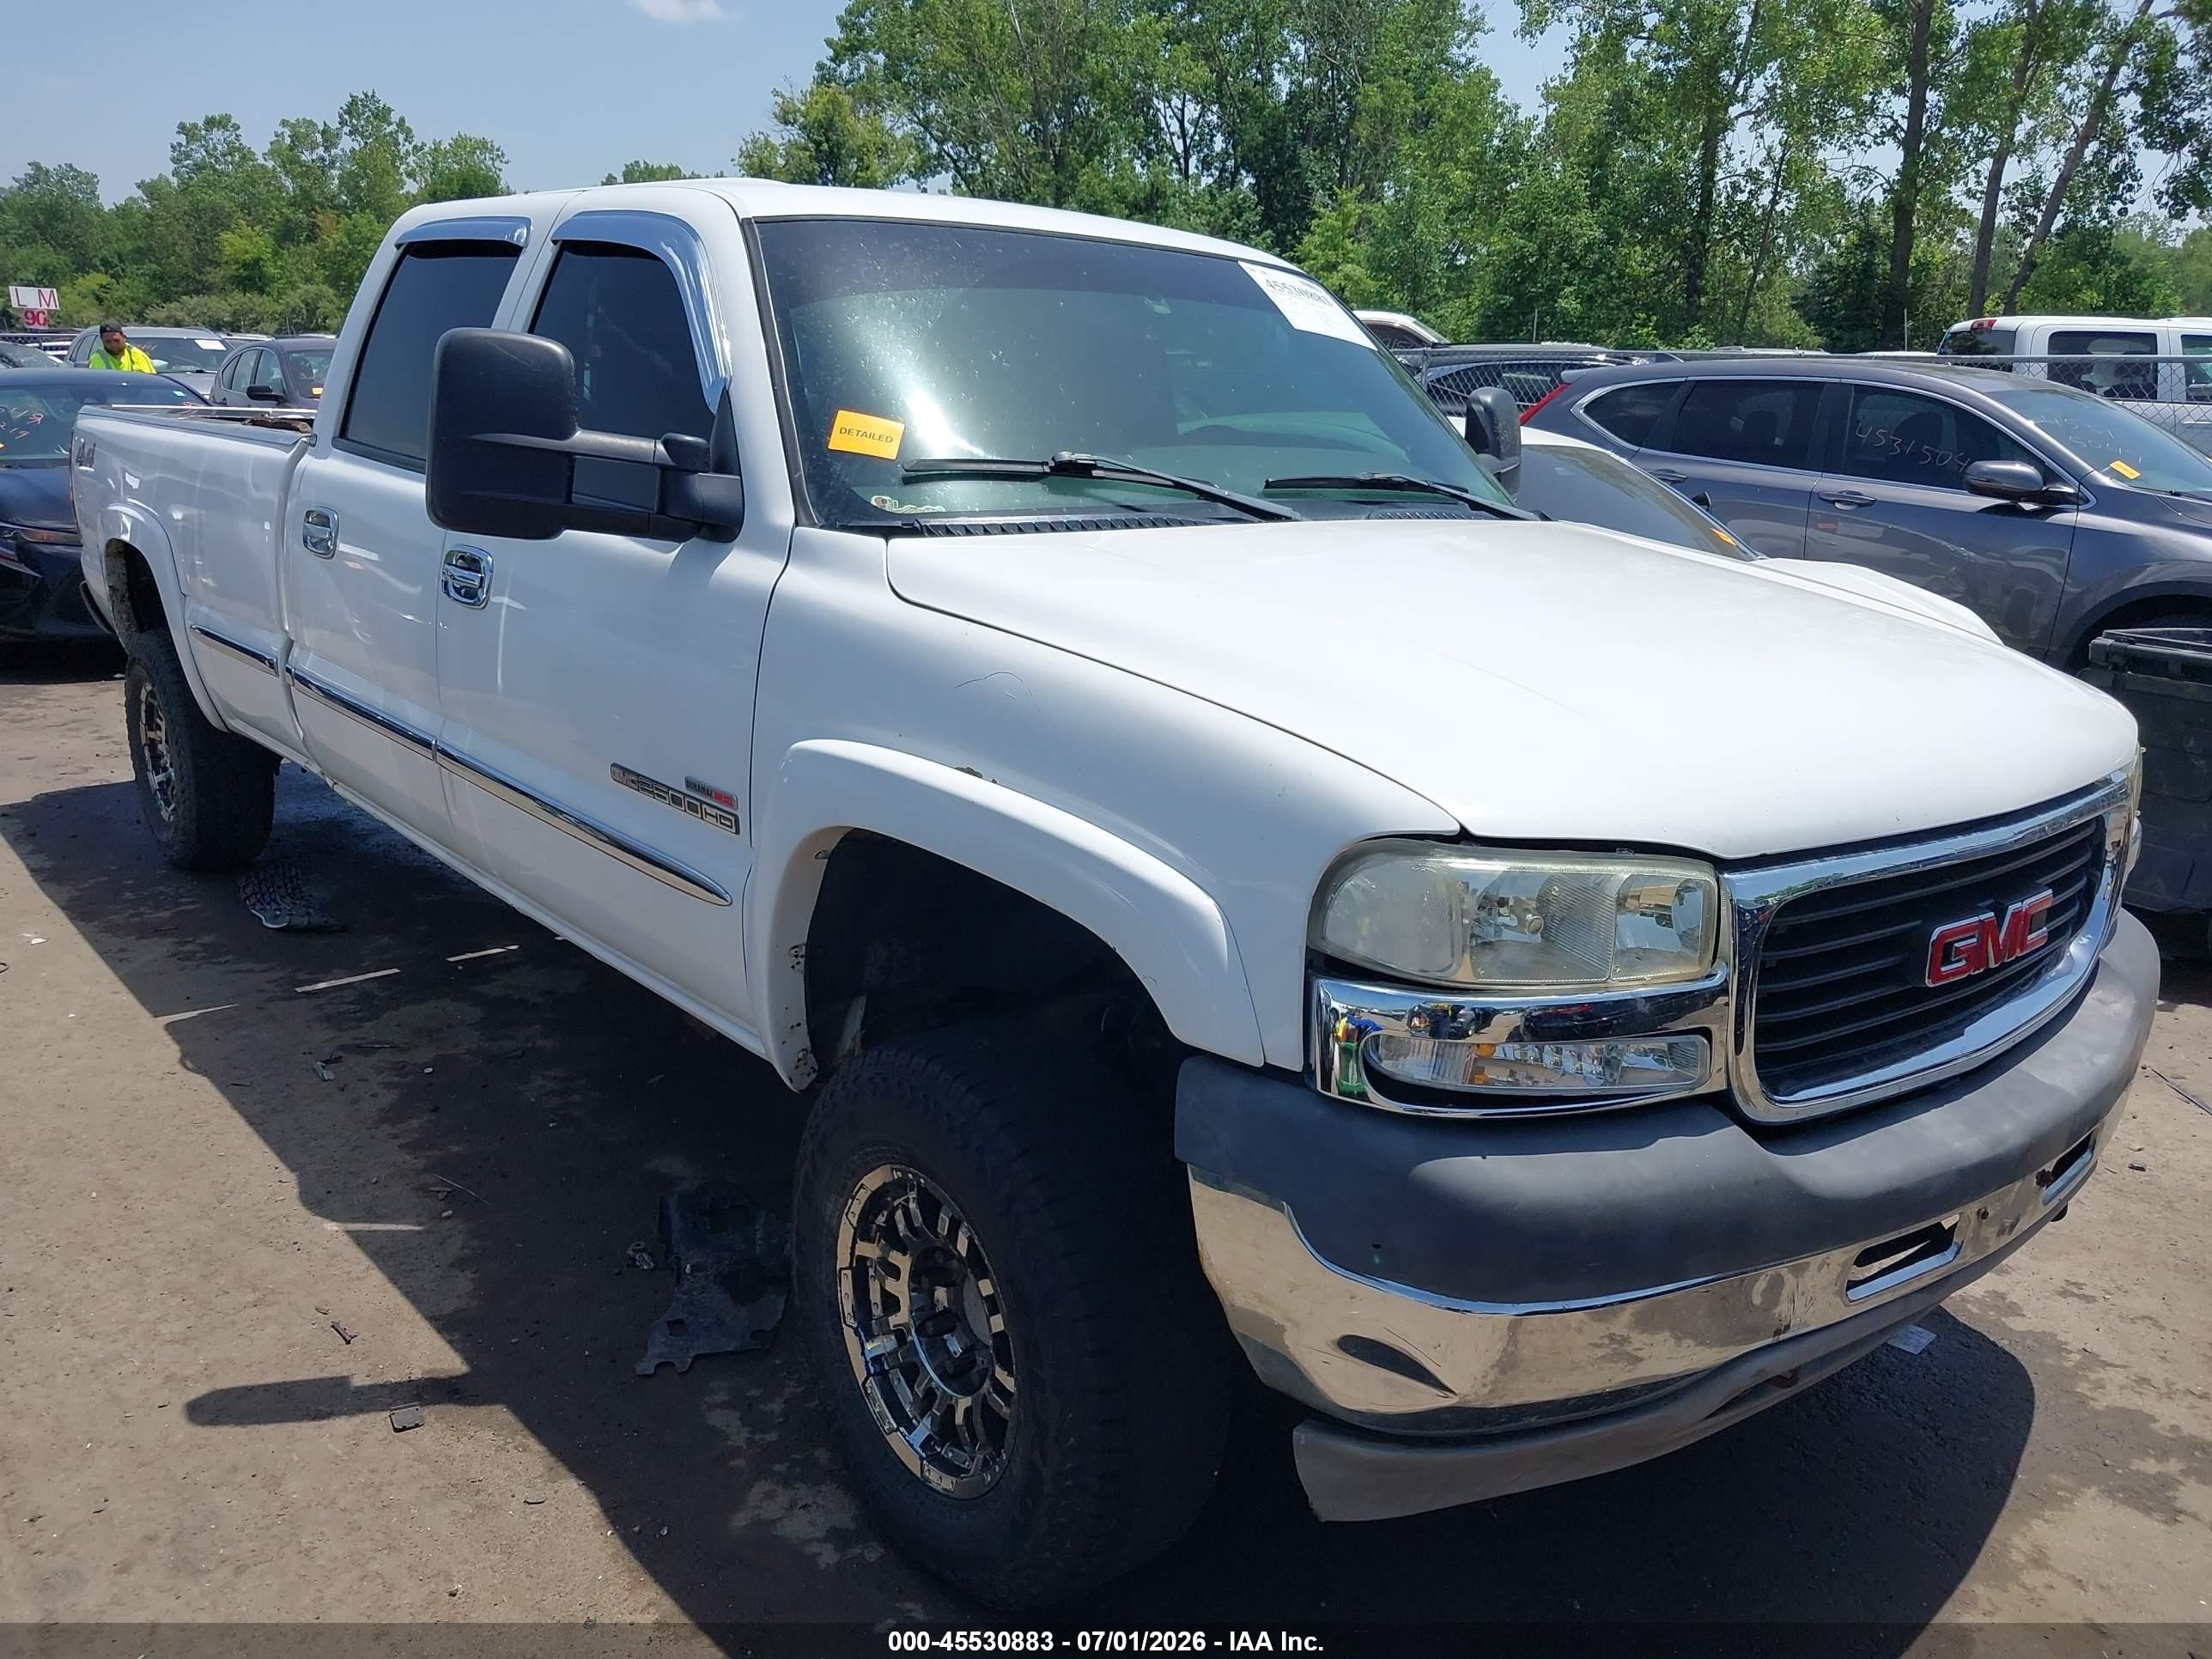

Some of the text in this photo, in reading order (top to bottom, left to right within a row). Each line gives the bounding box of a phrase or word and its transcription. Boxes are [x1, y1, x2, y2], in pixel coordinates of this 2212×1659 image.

[14, 287, 58, 308] L M
[24, 310, 48, 326] 90
[839, 427, 894, 443] DETAILED
[1855, 422, 1971, 472] 4531504
[1925, 888, 2054, 988] GMC
